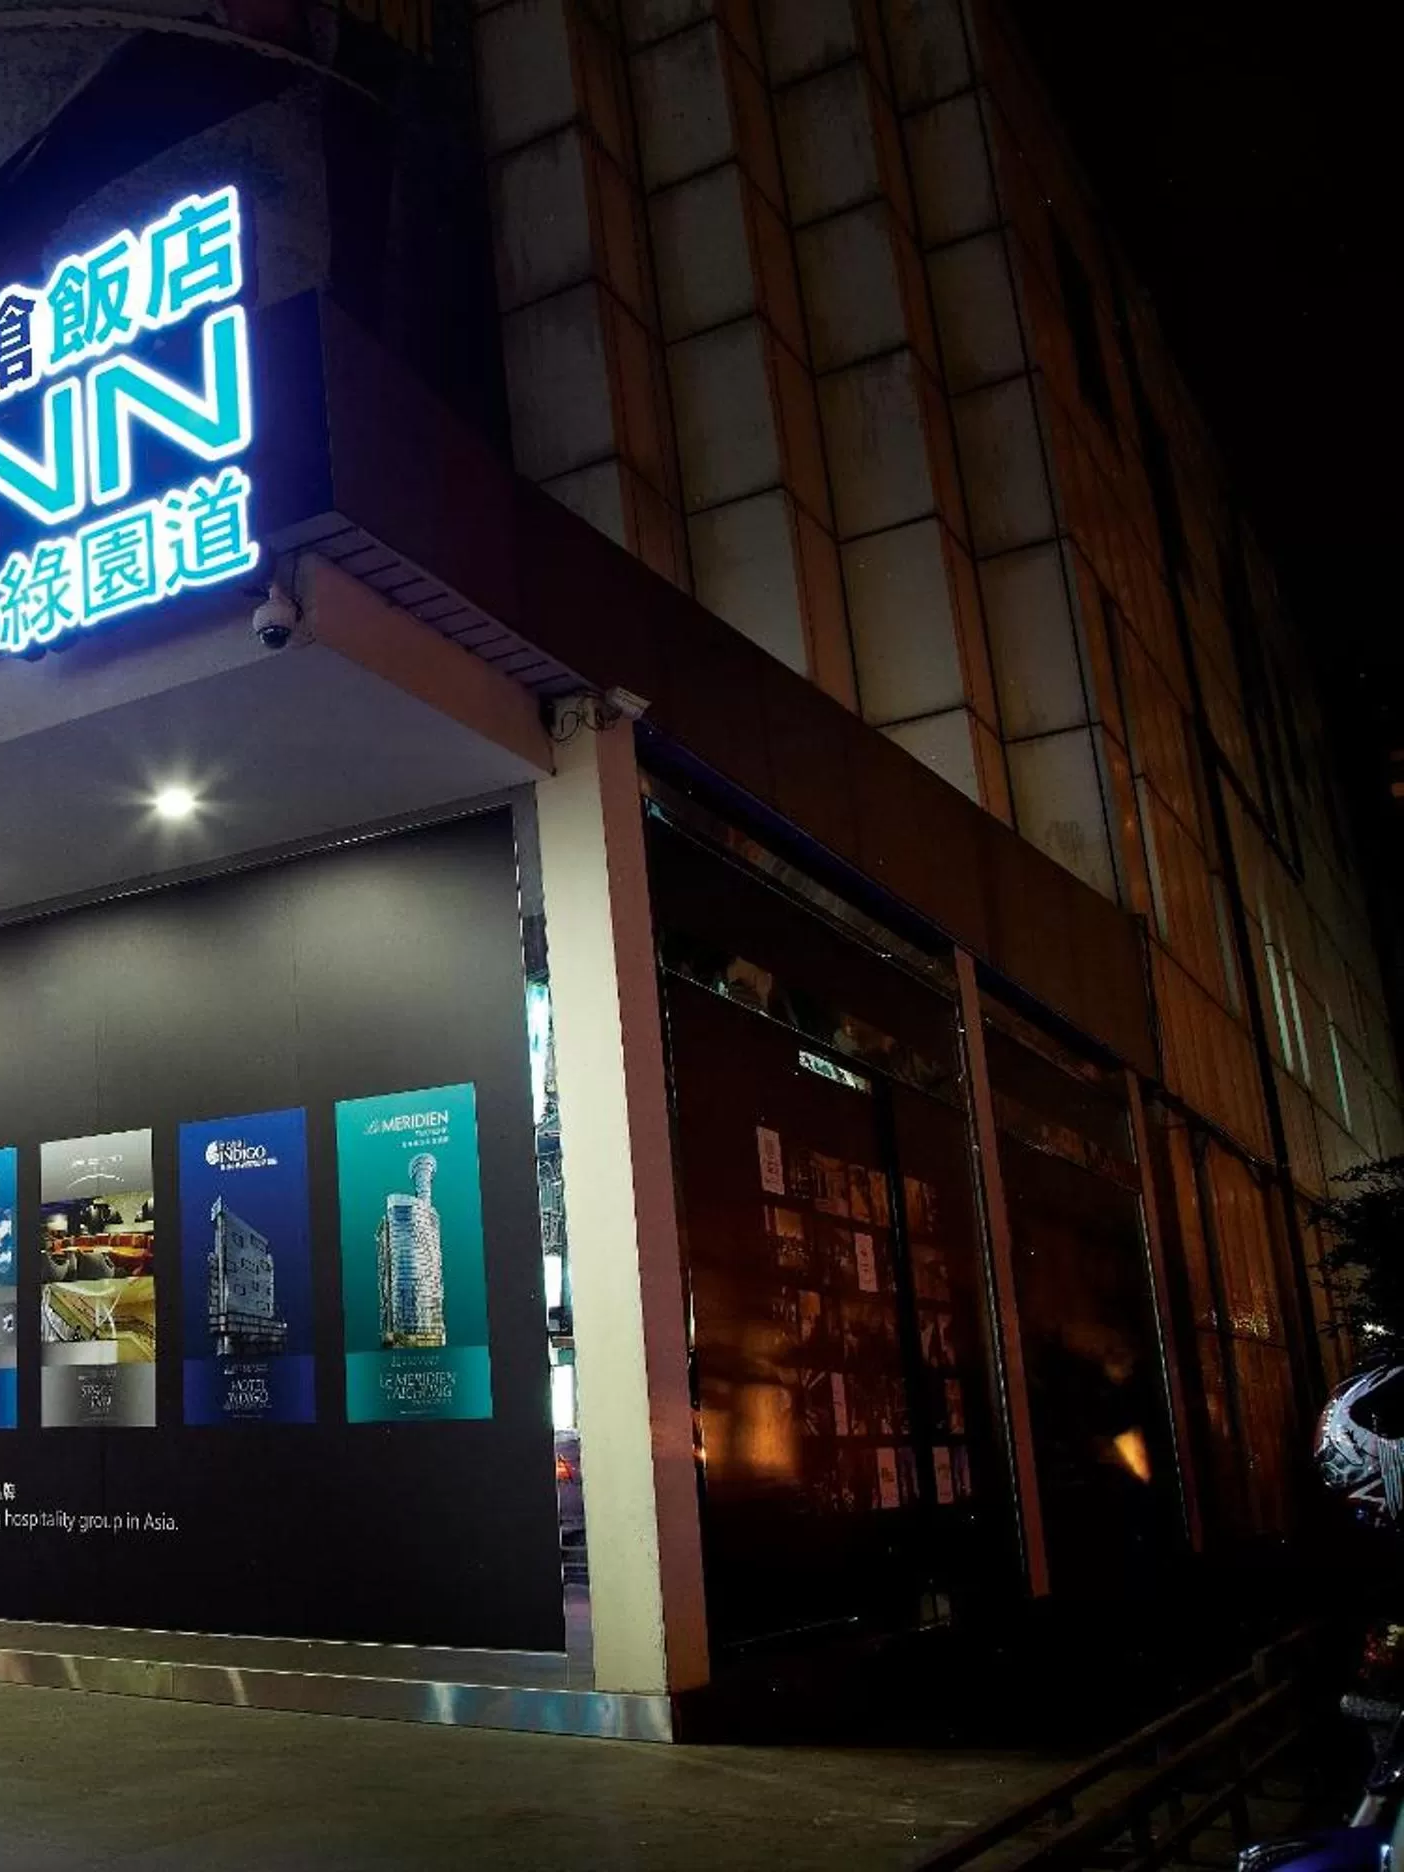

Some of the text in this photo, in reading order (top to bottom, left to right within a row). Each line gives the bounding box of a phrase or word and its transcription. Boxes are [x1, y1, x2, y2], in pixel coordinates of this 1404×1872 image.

[220, 1145, 267, 1162] INDIGO
[4, 1508, 76, 1532] hospitality
[79, 1514, 123, 1535] group
[126, 1511, 140, 1530] in
[143, 1511, 180, 1531] Asia.
